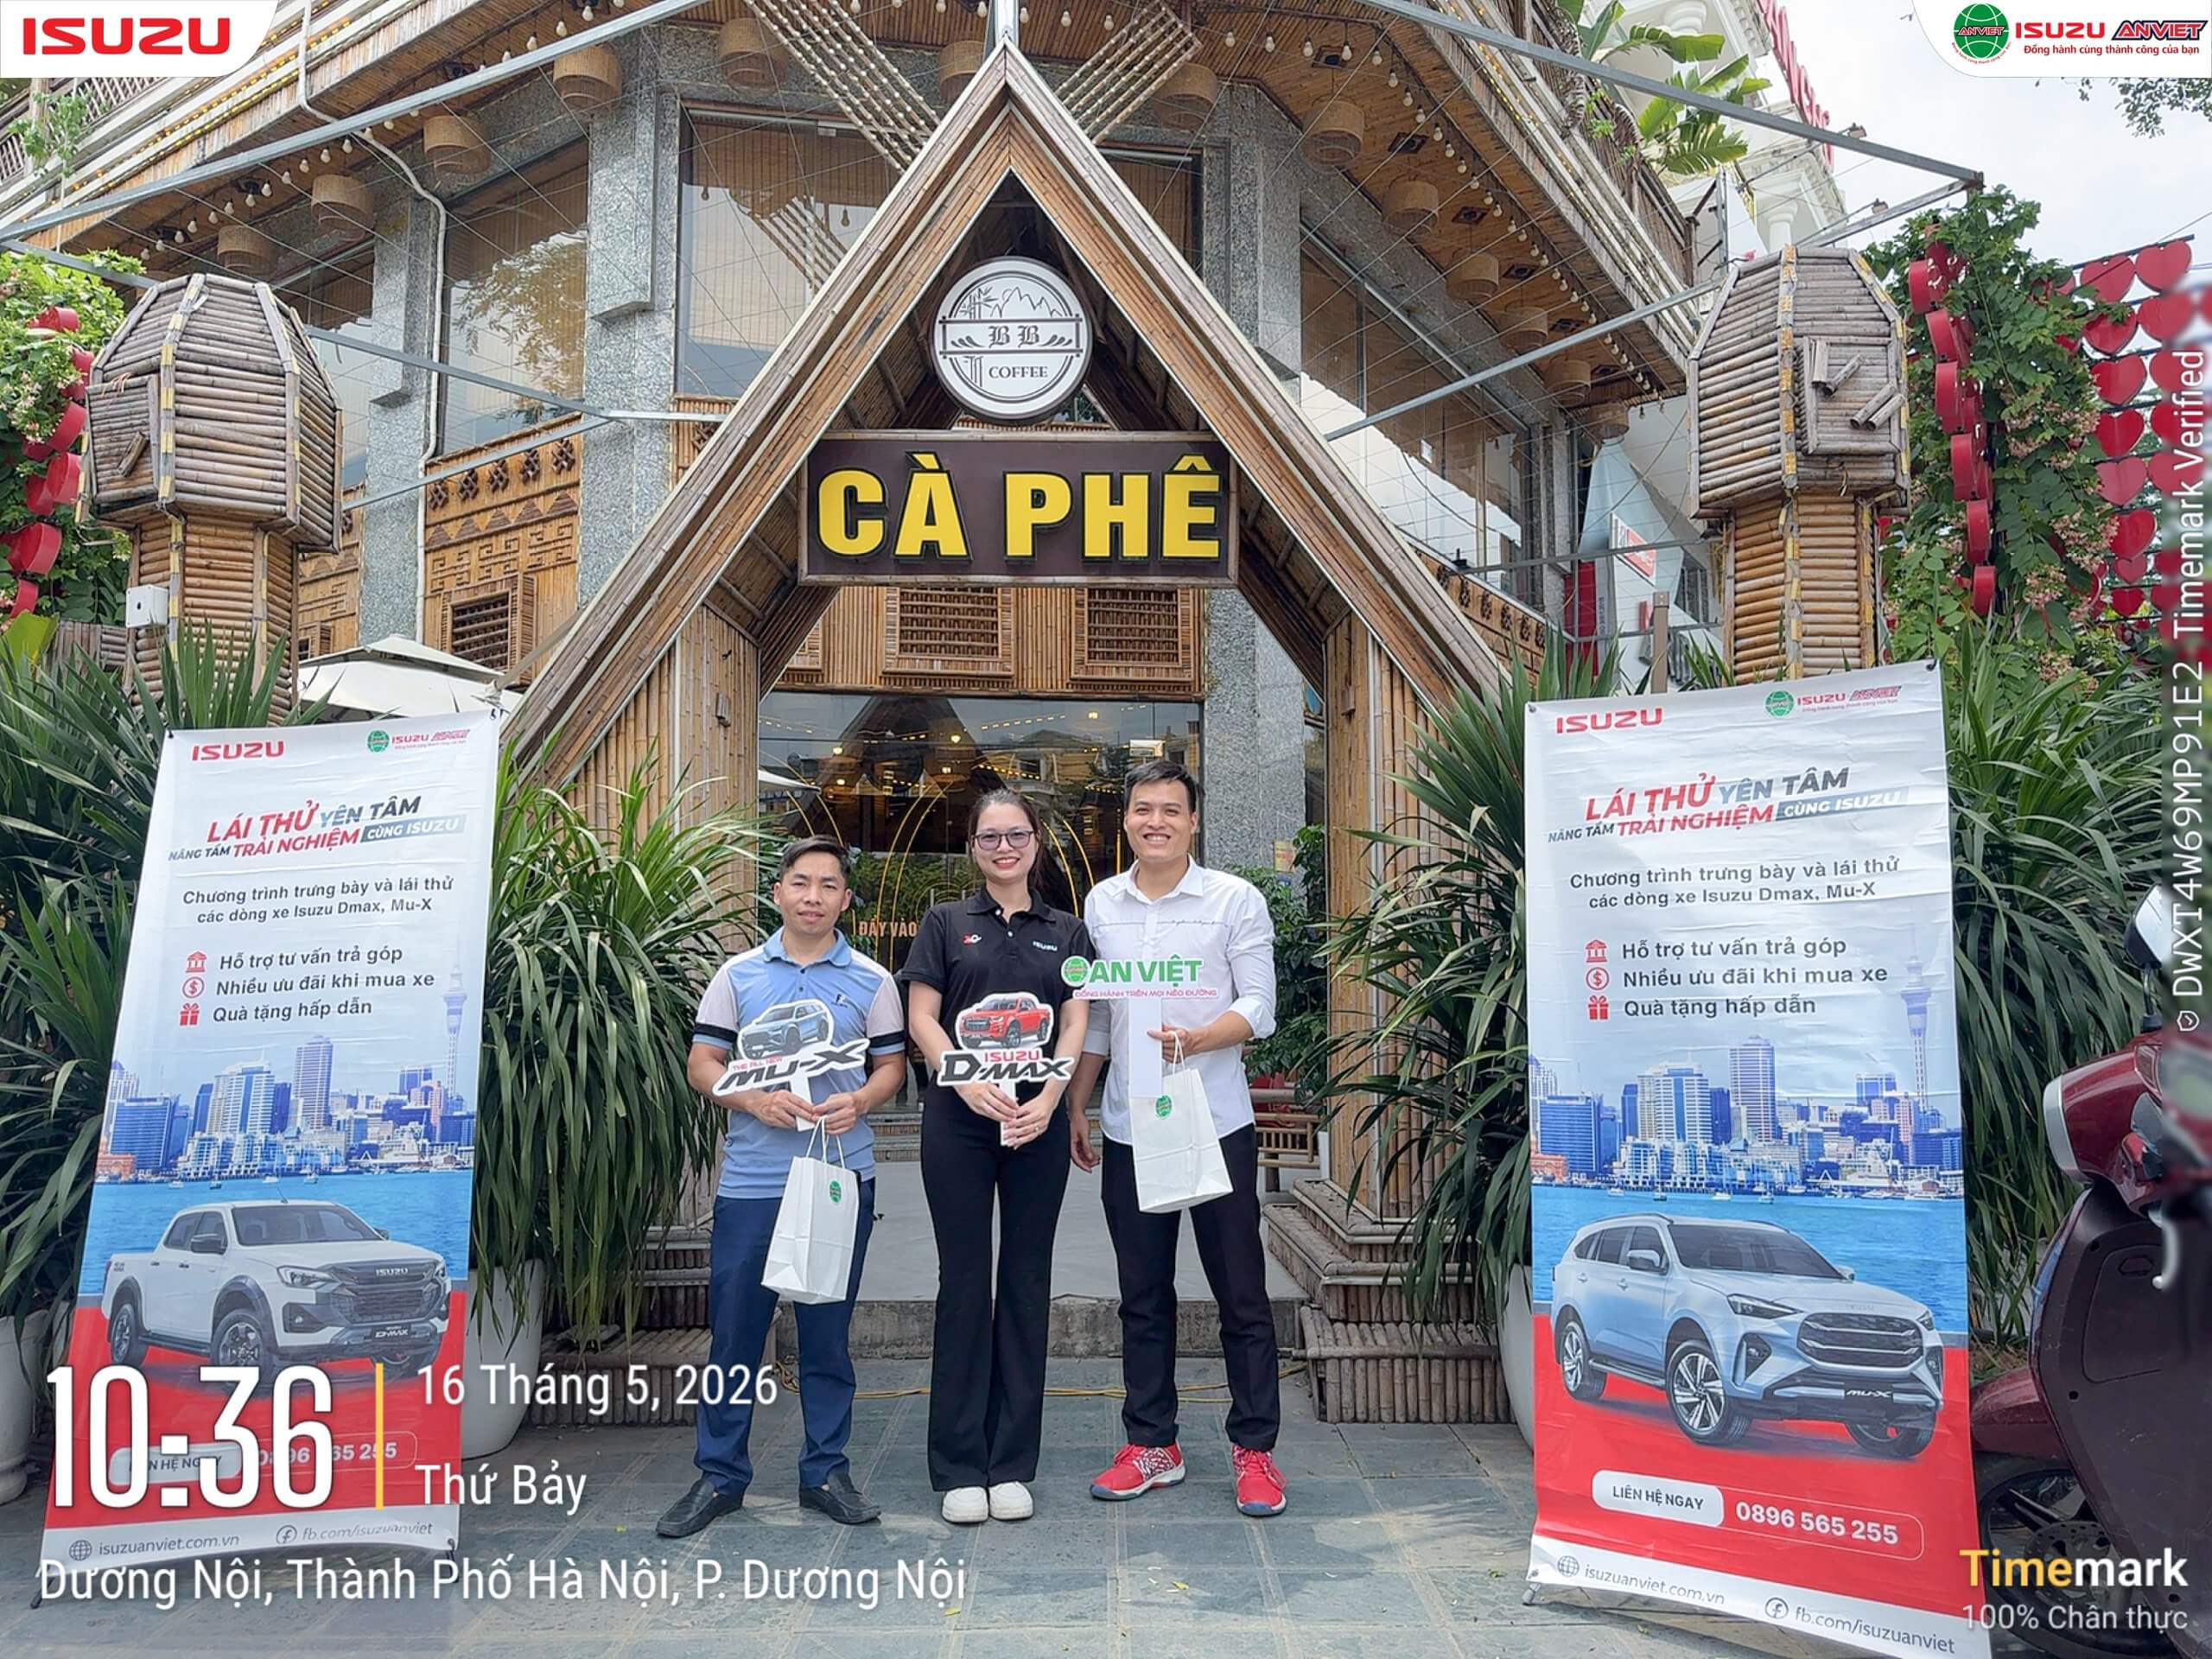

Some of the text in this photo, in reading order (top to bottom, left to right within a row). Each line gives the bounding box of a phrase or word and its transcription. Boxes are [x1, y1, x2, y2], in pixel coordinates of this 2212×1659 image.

[988, 366, 1048, 378] COFFEE
[817, 451, 1221, 558] CÀ PHÊ
[1797, 693, 1846, 705] ISUZU
[1555, 708, 1663, 734] ISUZU
[192, 741, 285, 760] ISUZU
[392, 734, 429, 744] ISUZU
[1586, 767, 1849, 821] LÁI THỬ YÊN TÂM
[207, 795, 422, 843] LÁI THỬ YÊN TÂM
[1548, 827, 1582, 843] NÂNG
[1618, 814, 1664, 836] TRẢI
[1670, 804, 1773, 830] NGHIỆM
[1783, 799, 1829, 817] CÙNG
[1834, 791, 1899, 810] ISUZU
[168, 847, 201, 861] NÂNG
[233, 836, 273, 858] TRẢI
[276, 829, 359, 852] NGHIỆM
[368, 825, 403, 841] CÙNG
[406, 820, 459, 834] ISUZU
[1570, 856, 1900, 890] Chương trình trưng bày và lái thử
[183, 876, 454, 905] Chương trình trưng bày và lái thử
[1589, 881, 1876, 909] các dòng xe Isuzu Dmax, Mu-X
[197, 898, 433, 924] các dòng xe Isuzu Dmax, Mu-X
[890, 917, 918, 937] VÀO
[219, 945, 404, 970] Hỗ trợ tư vấn trả góp
[1622, 936, 1847, 961] Hỗ trợ tư vấn trả góp
[216, 972, 435, 995] Nhiều ưu đãi khi mua xe
[1089, 954, 1202, 987] AN VIỆT
[1623, 966, 1888, 988] Nhiều ưu đãi khi mua xe
[213, 997, 372, 1023] Quà tặng hấp dẫn
[1624, 993, 1816, 1020] Quà tặng hấp dẫn
[941, 1053, 1071, 1082] D-MAX
[984, 1051, 1040, 1062] ISUZU
[375, 1268, 409, 1276] ISUZU
[181, 1455, 222, 1469] NGY
[1612, 1483, 1898, 1545] LIÊN HỆ NGAY 0896 565 255
[99, 1521, 434, 1556] isuzuanviet.com.vn fb.com/isuzuanviet
[1584, 1565, 1955, 1654] isuzuanviet.com.vn fb.com/isuzuanviet
